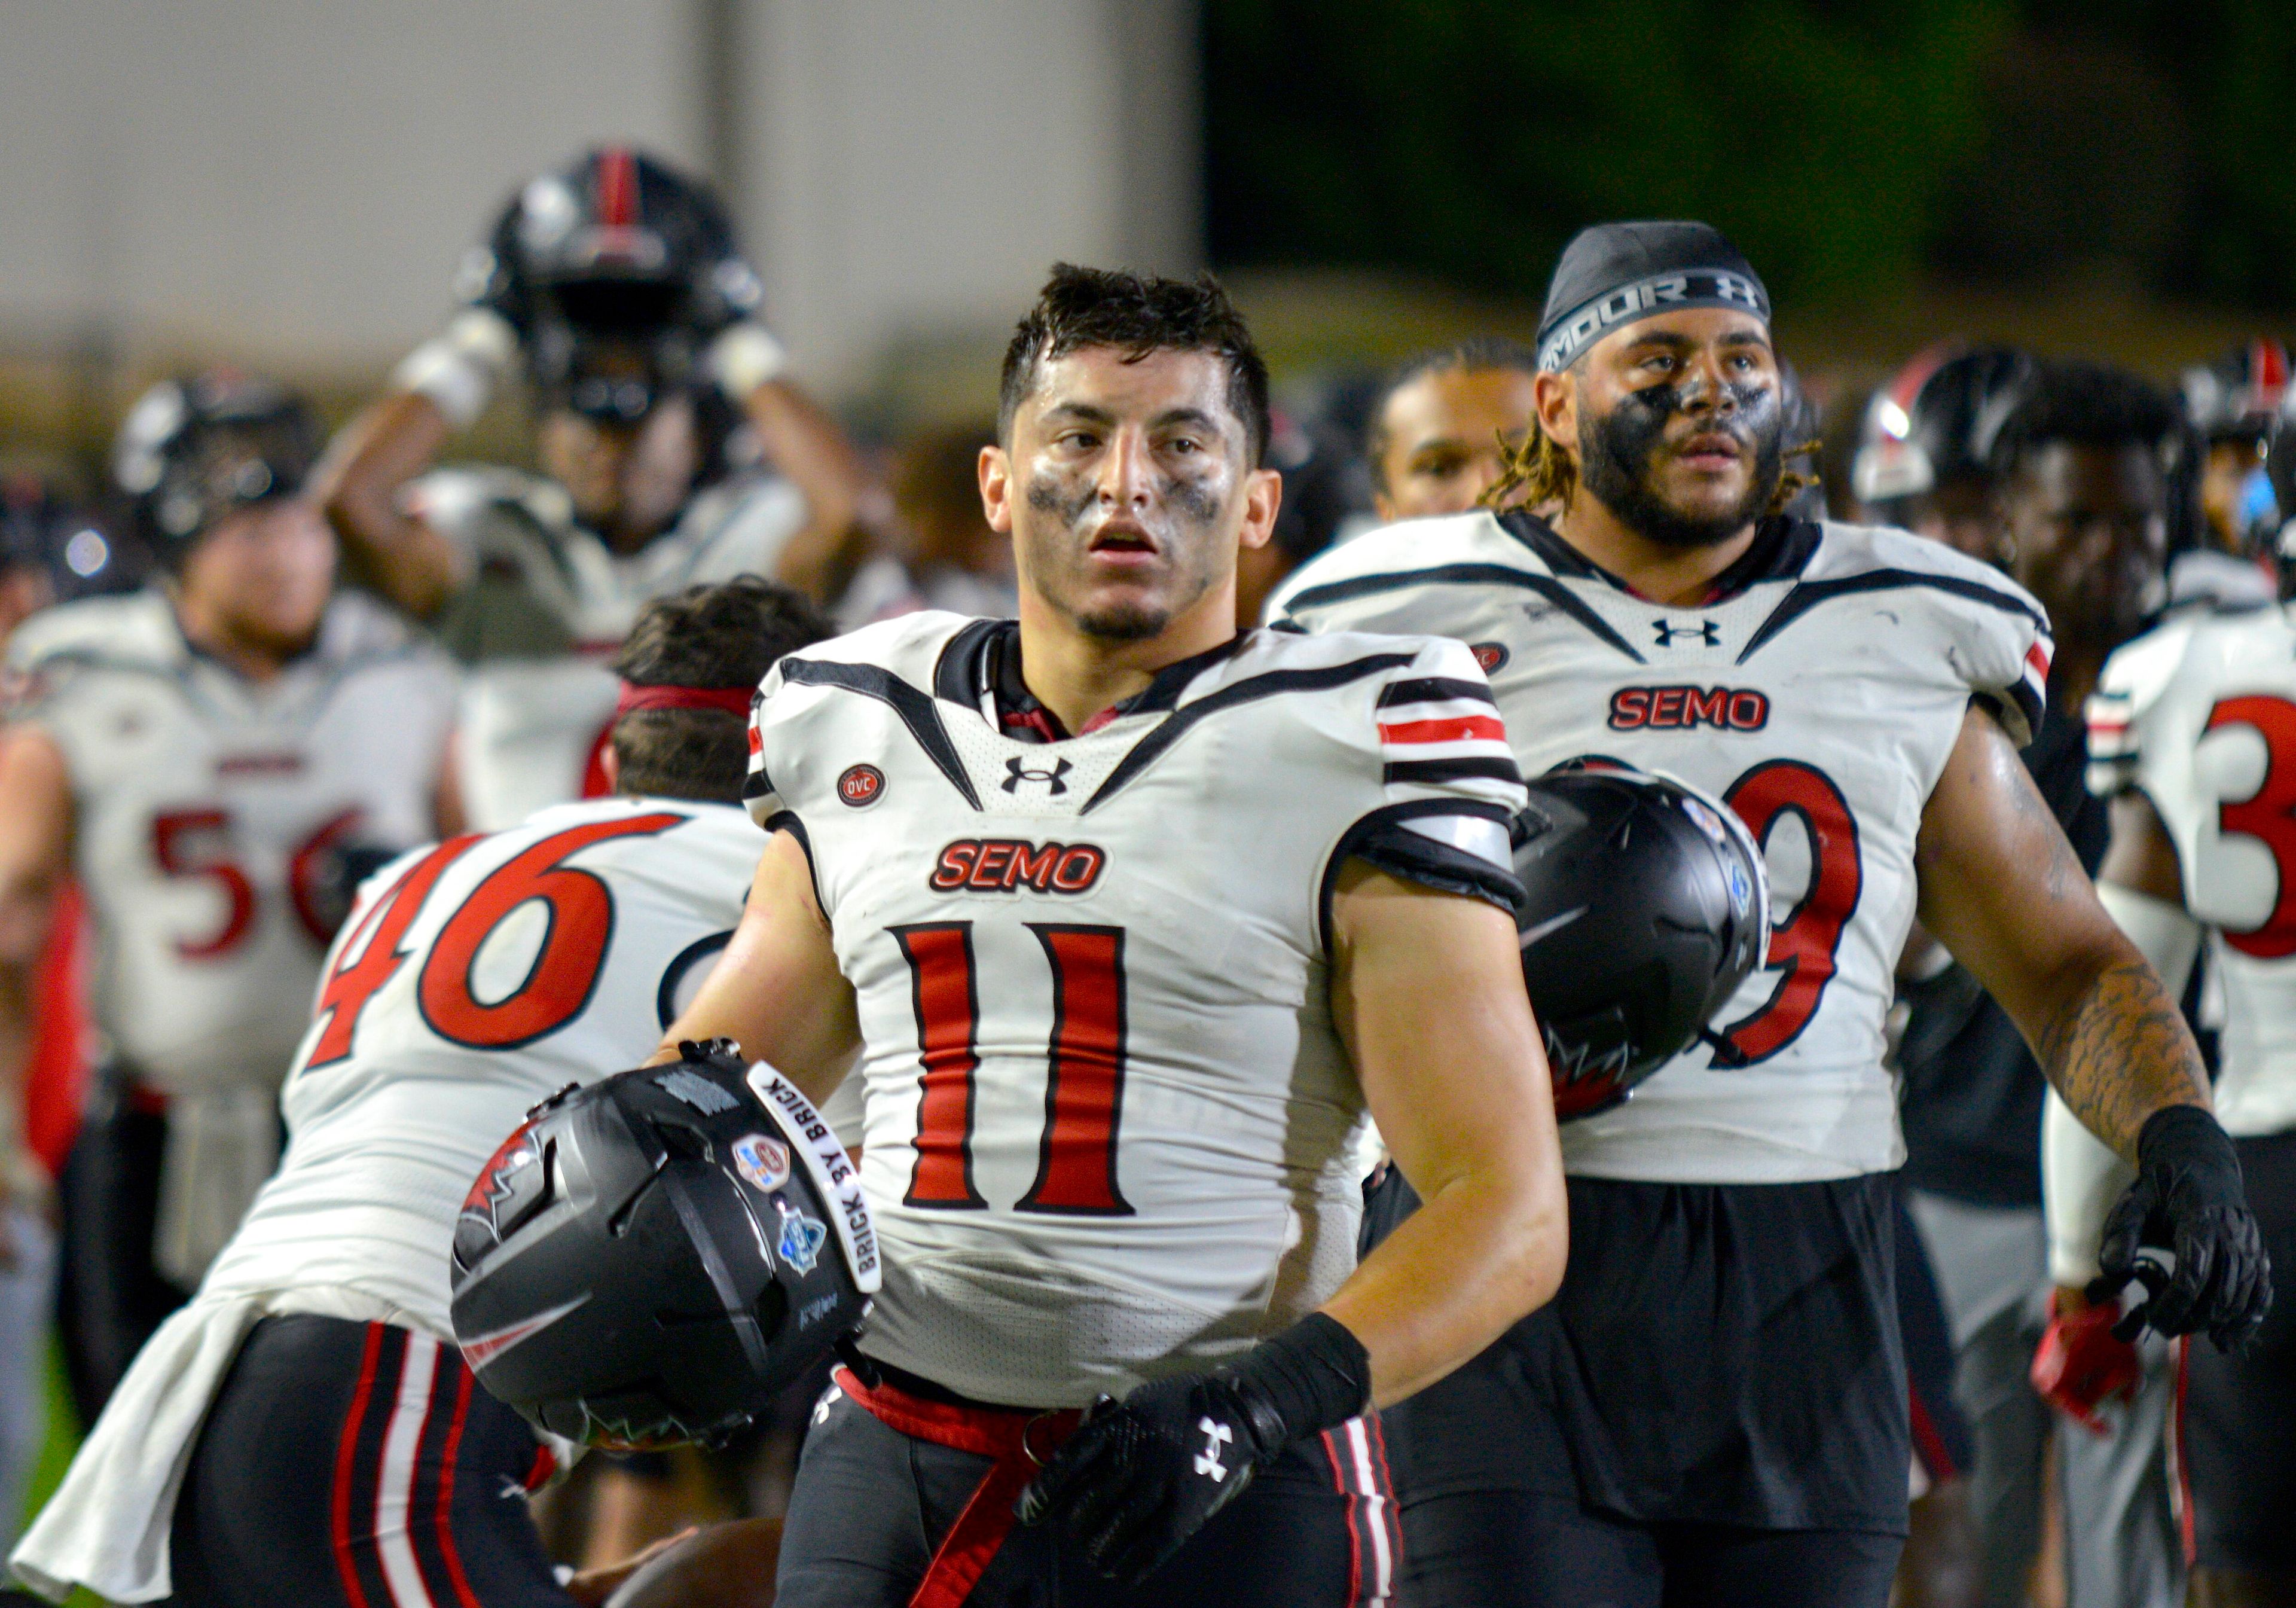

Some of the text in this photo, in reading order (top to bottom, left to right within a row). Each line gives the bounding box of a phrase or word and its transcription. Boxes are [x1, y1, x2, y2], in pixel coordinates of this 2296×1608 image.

[1608, 685, 1770, 733] SEMO
[847, 777, 872, 795] OVC
[929, 838, 1106, 893] SEMO
[299, 811, 695, 1074] 46
[883, 920, 1137, 1216] 11
[761, 1078, 878, 1276] BRICK BY BRICK
